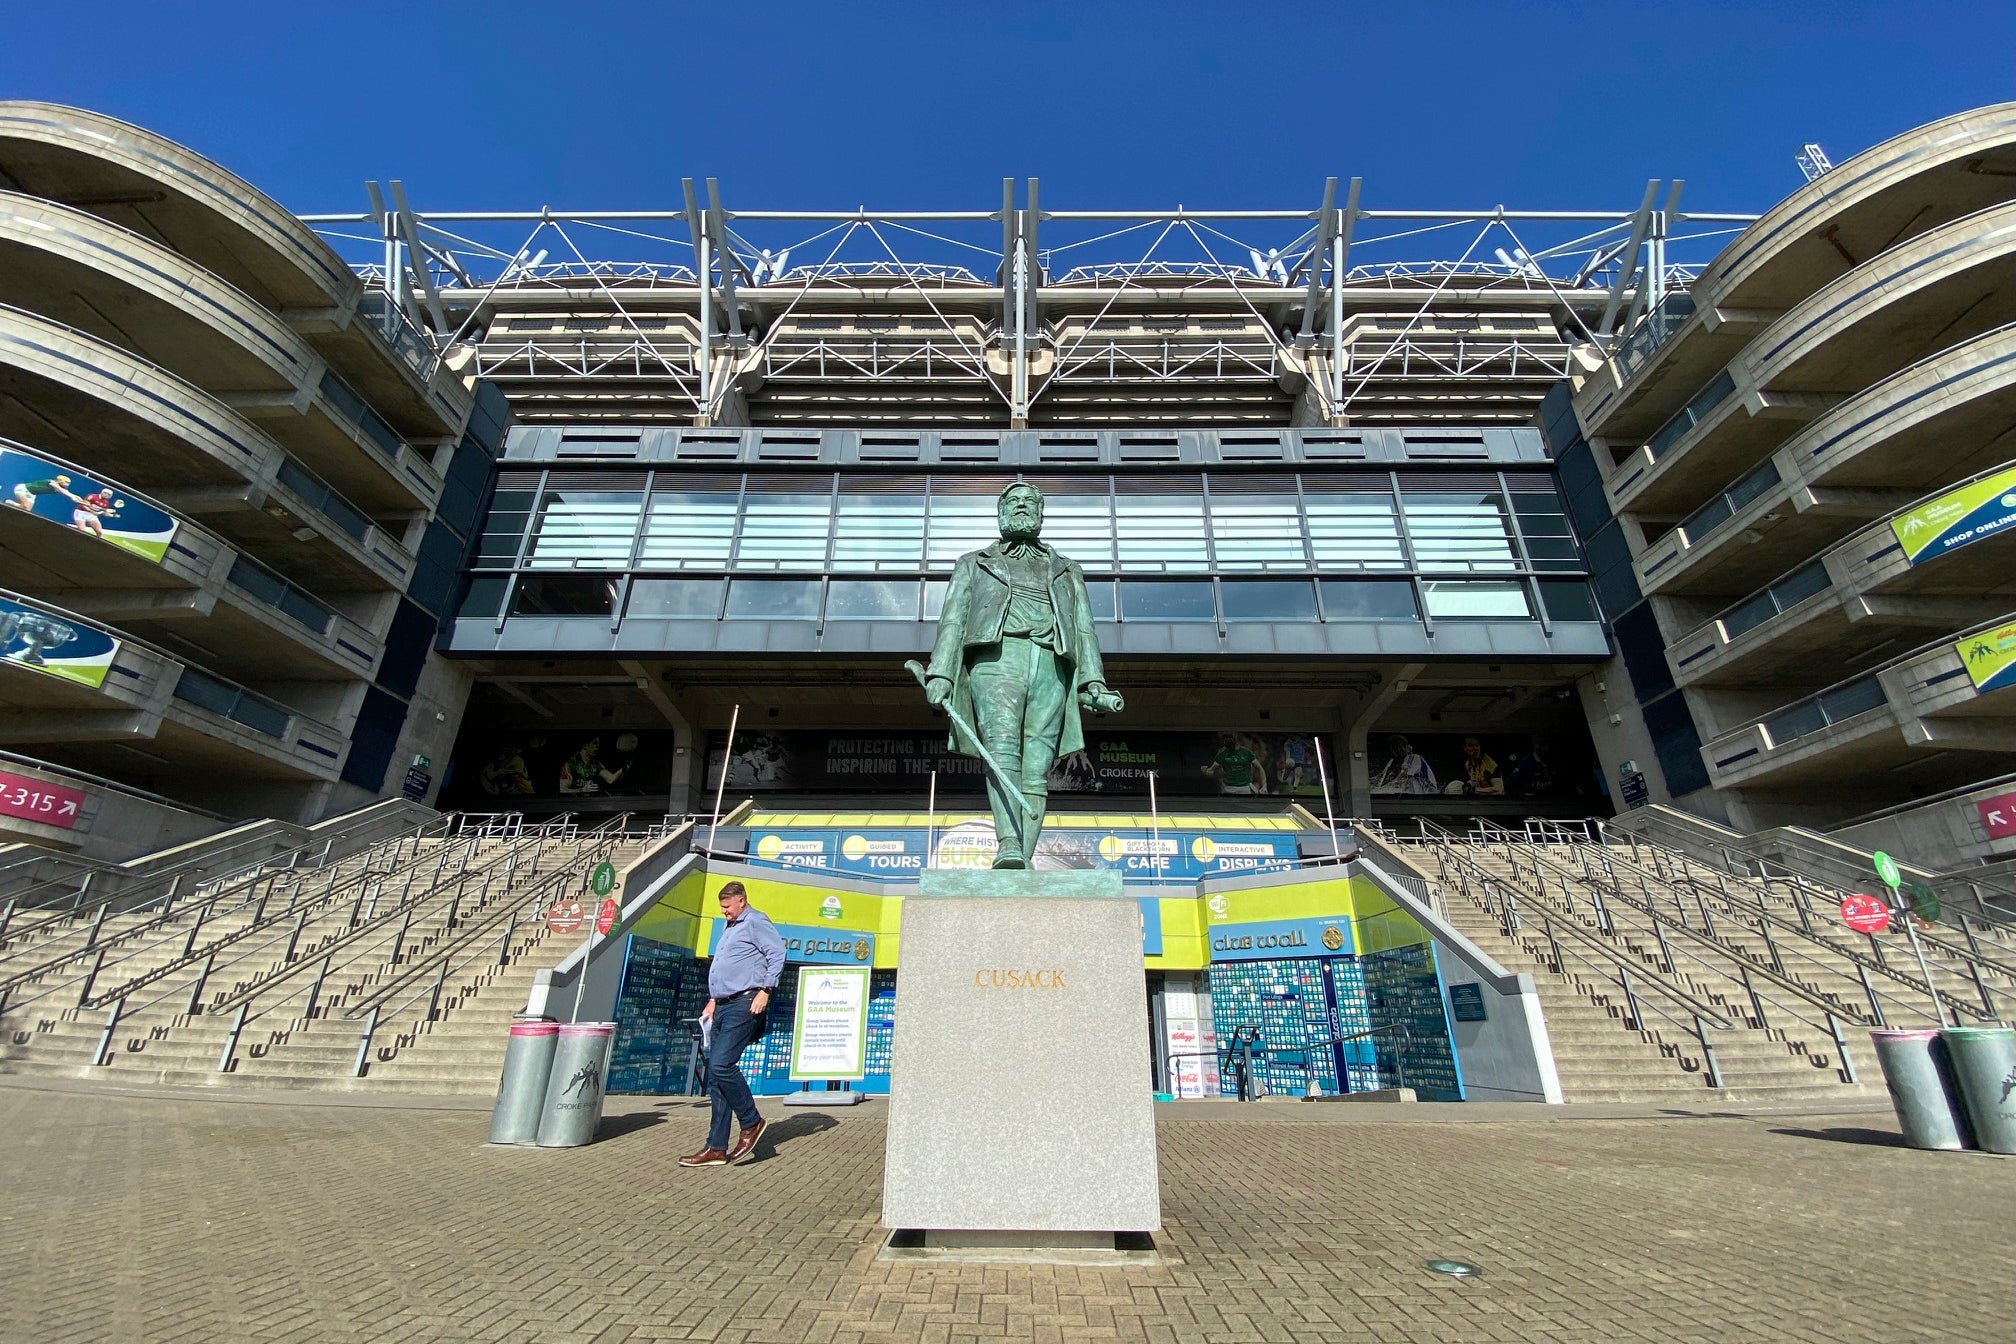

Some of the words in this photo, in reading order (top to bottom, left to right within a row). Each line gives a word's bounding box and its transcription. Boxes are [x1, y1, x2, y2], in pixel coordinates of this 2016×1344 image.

[1944, 530, 1974, 547] SHOP
[828, 739, 914, 754] PROTECTING
[920, 739, 948, 754] THE
[1100, 741, 1129, 752] GAA
[1100, 752, 1157, 763] MUSEUM
[826, 758, 897, 774] INSPIRING
[903, 758, 932, 774] THE
[937, 759, 985, 774] FUTUR
[1099, 767, 1134, 778] CROKE
[943, 836, 975, 846] WHERE
[783, 855, 828, 868] ZONE
[868, 855, 922, 868] TOURS
[1218, 858, 1292, 872] DISPLAYS
[1257, 929, 1308, 949] wall
[975, 969, 1067, 989] CUSACK
[556, 1102, 582, 1110] CROKE
